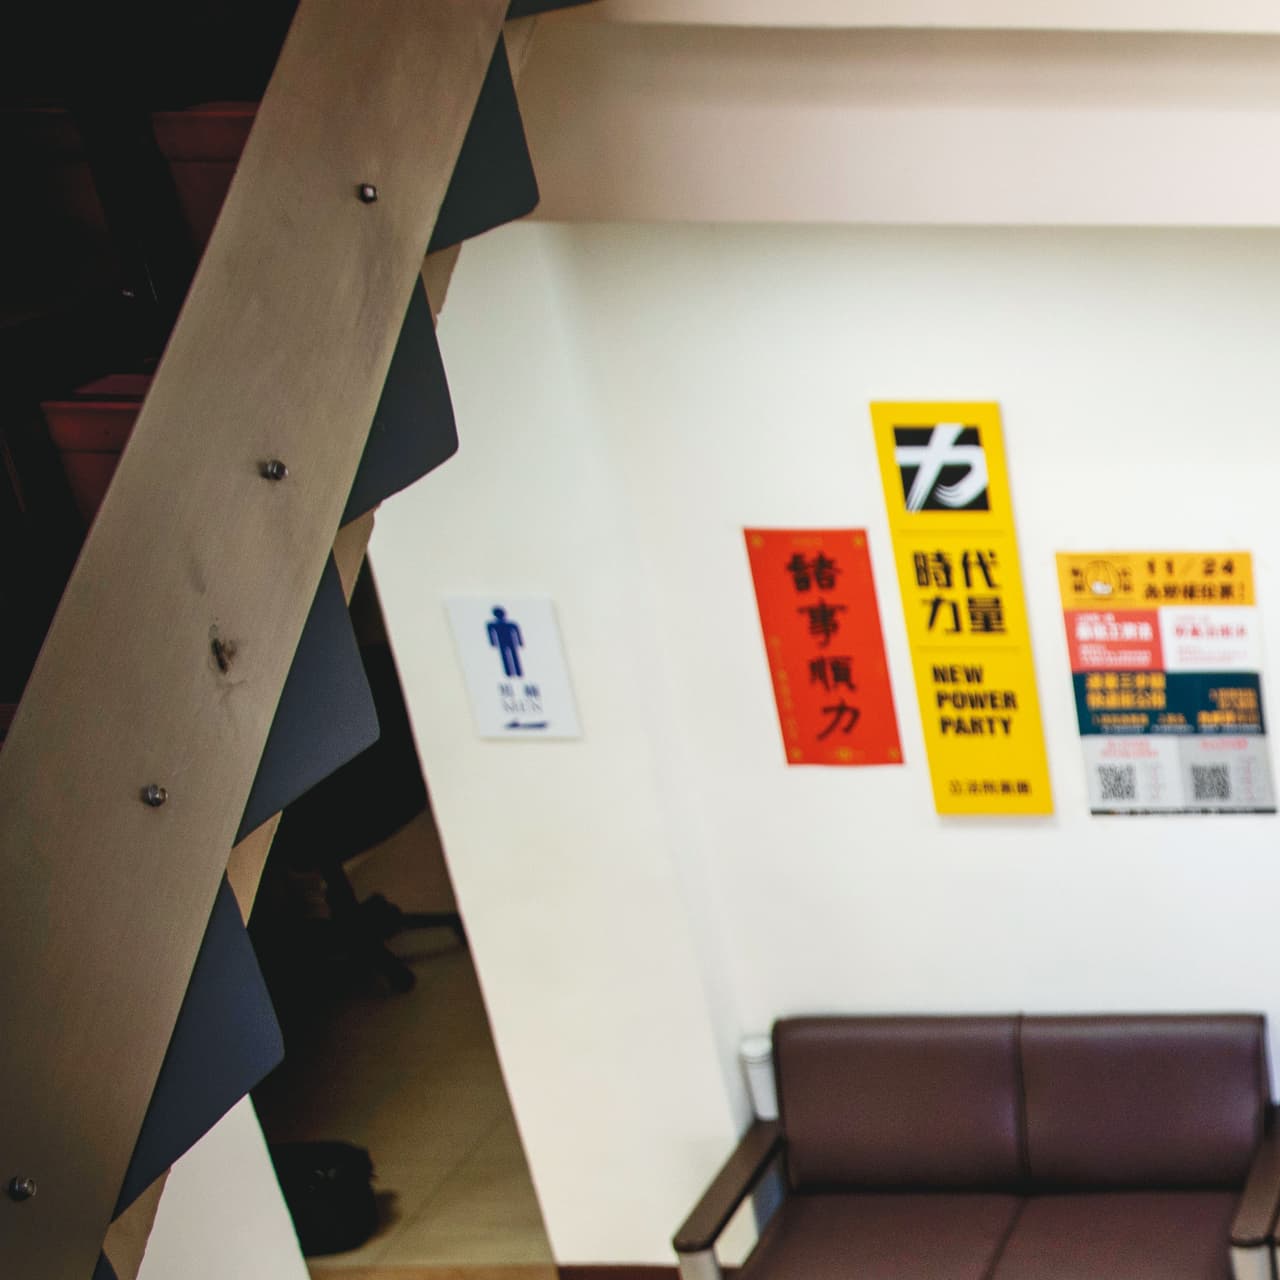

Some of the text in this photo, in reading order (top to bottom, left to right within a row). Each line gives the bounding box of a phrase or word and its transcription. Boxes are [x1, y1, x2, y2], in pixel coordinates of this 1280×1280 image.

[913, 551, 999, 588] 時代
[922, 595, 1004, 634] 力量
[932, 665, 983, 684] NEW
[936, 690, 1018, 710] POWER
[940, 716, 1012, 735] PARTY
